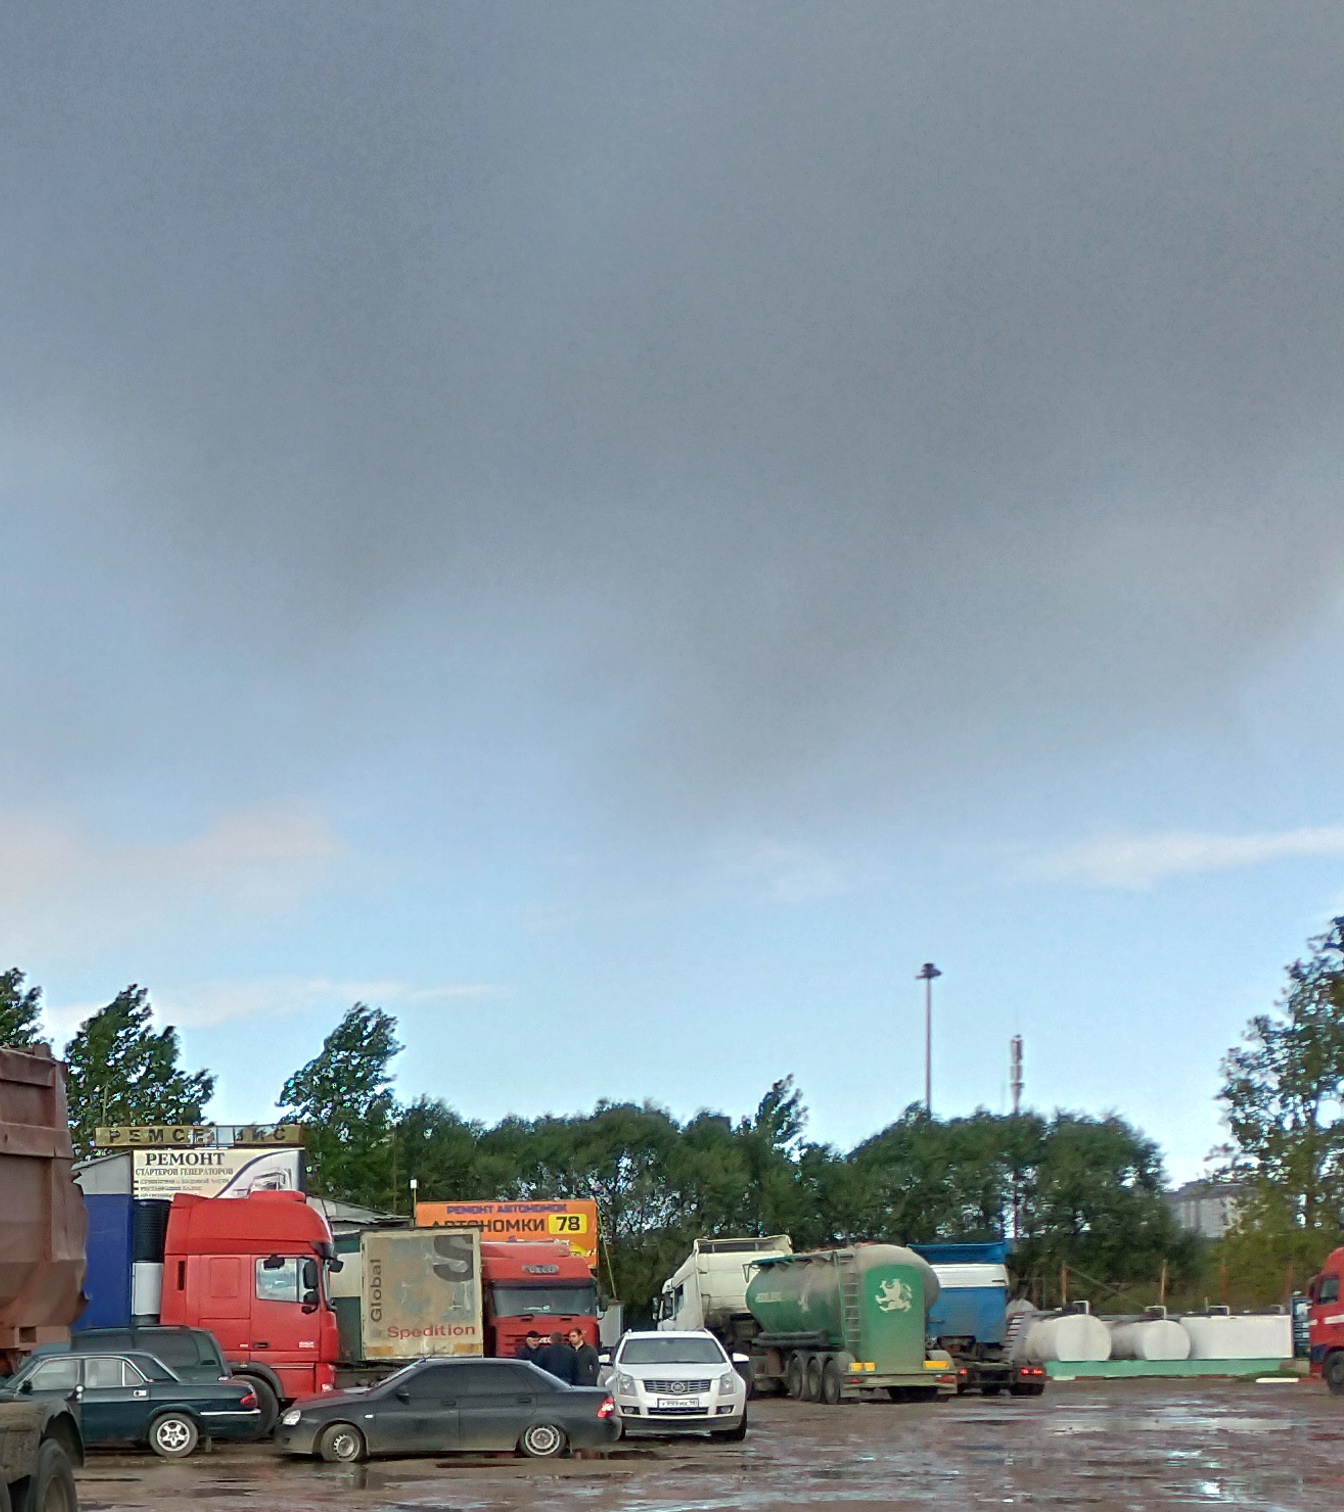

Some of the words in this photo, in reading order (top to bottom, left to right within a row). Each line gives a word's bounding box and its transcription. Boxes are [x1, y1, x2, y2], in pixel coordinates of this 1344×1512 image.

[145, 1152, 224, 1166] РЕМОНТ
[135, 1168, 179, 1176] СТАРТЕРОВ
[446, 1204, 493, 1214] РЕМОНТ
[555, 1216, 580, 1231] 78
[370, 1259, 382, 1322] Global
[387, 1324, 476, 1339] Spedition
